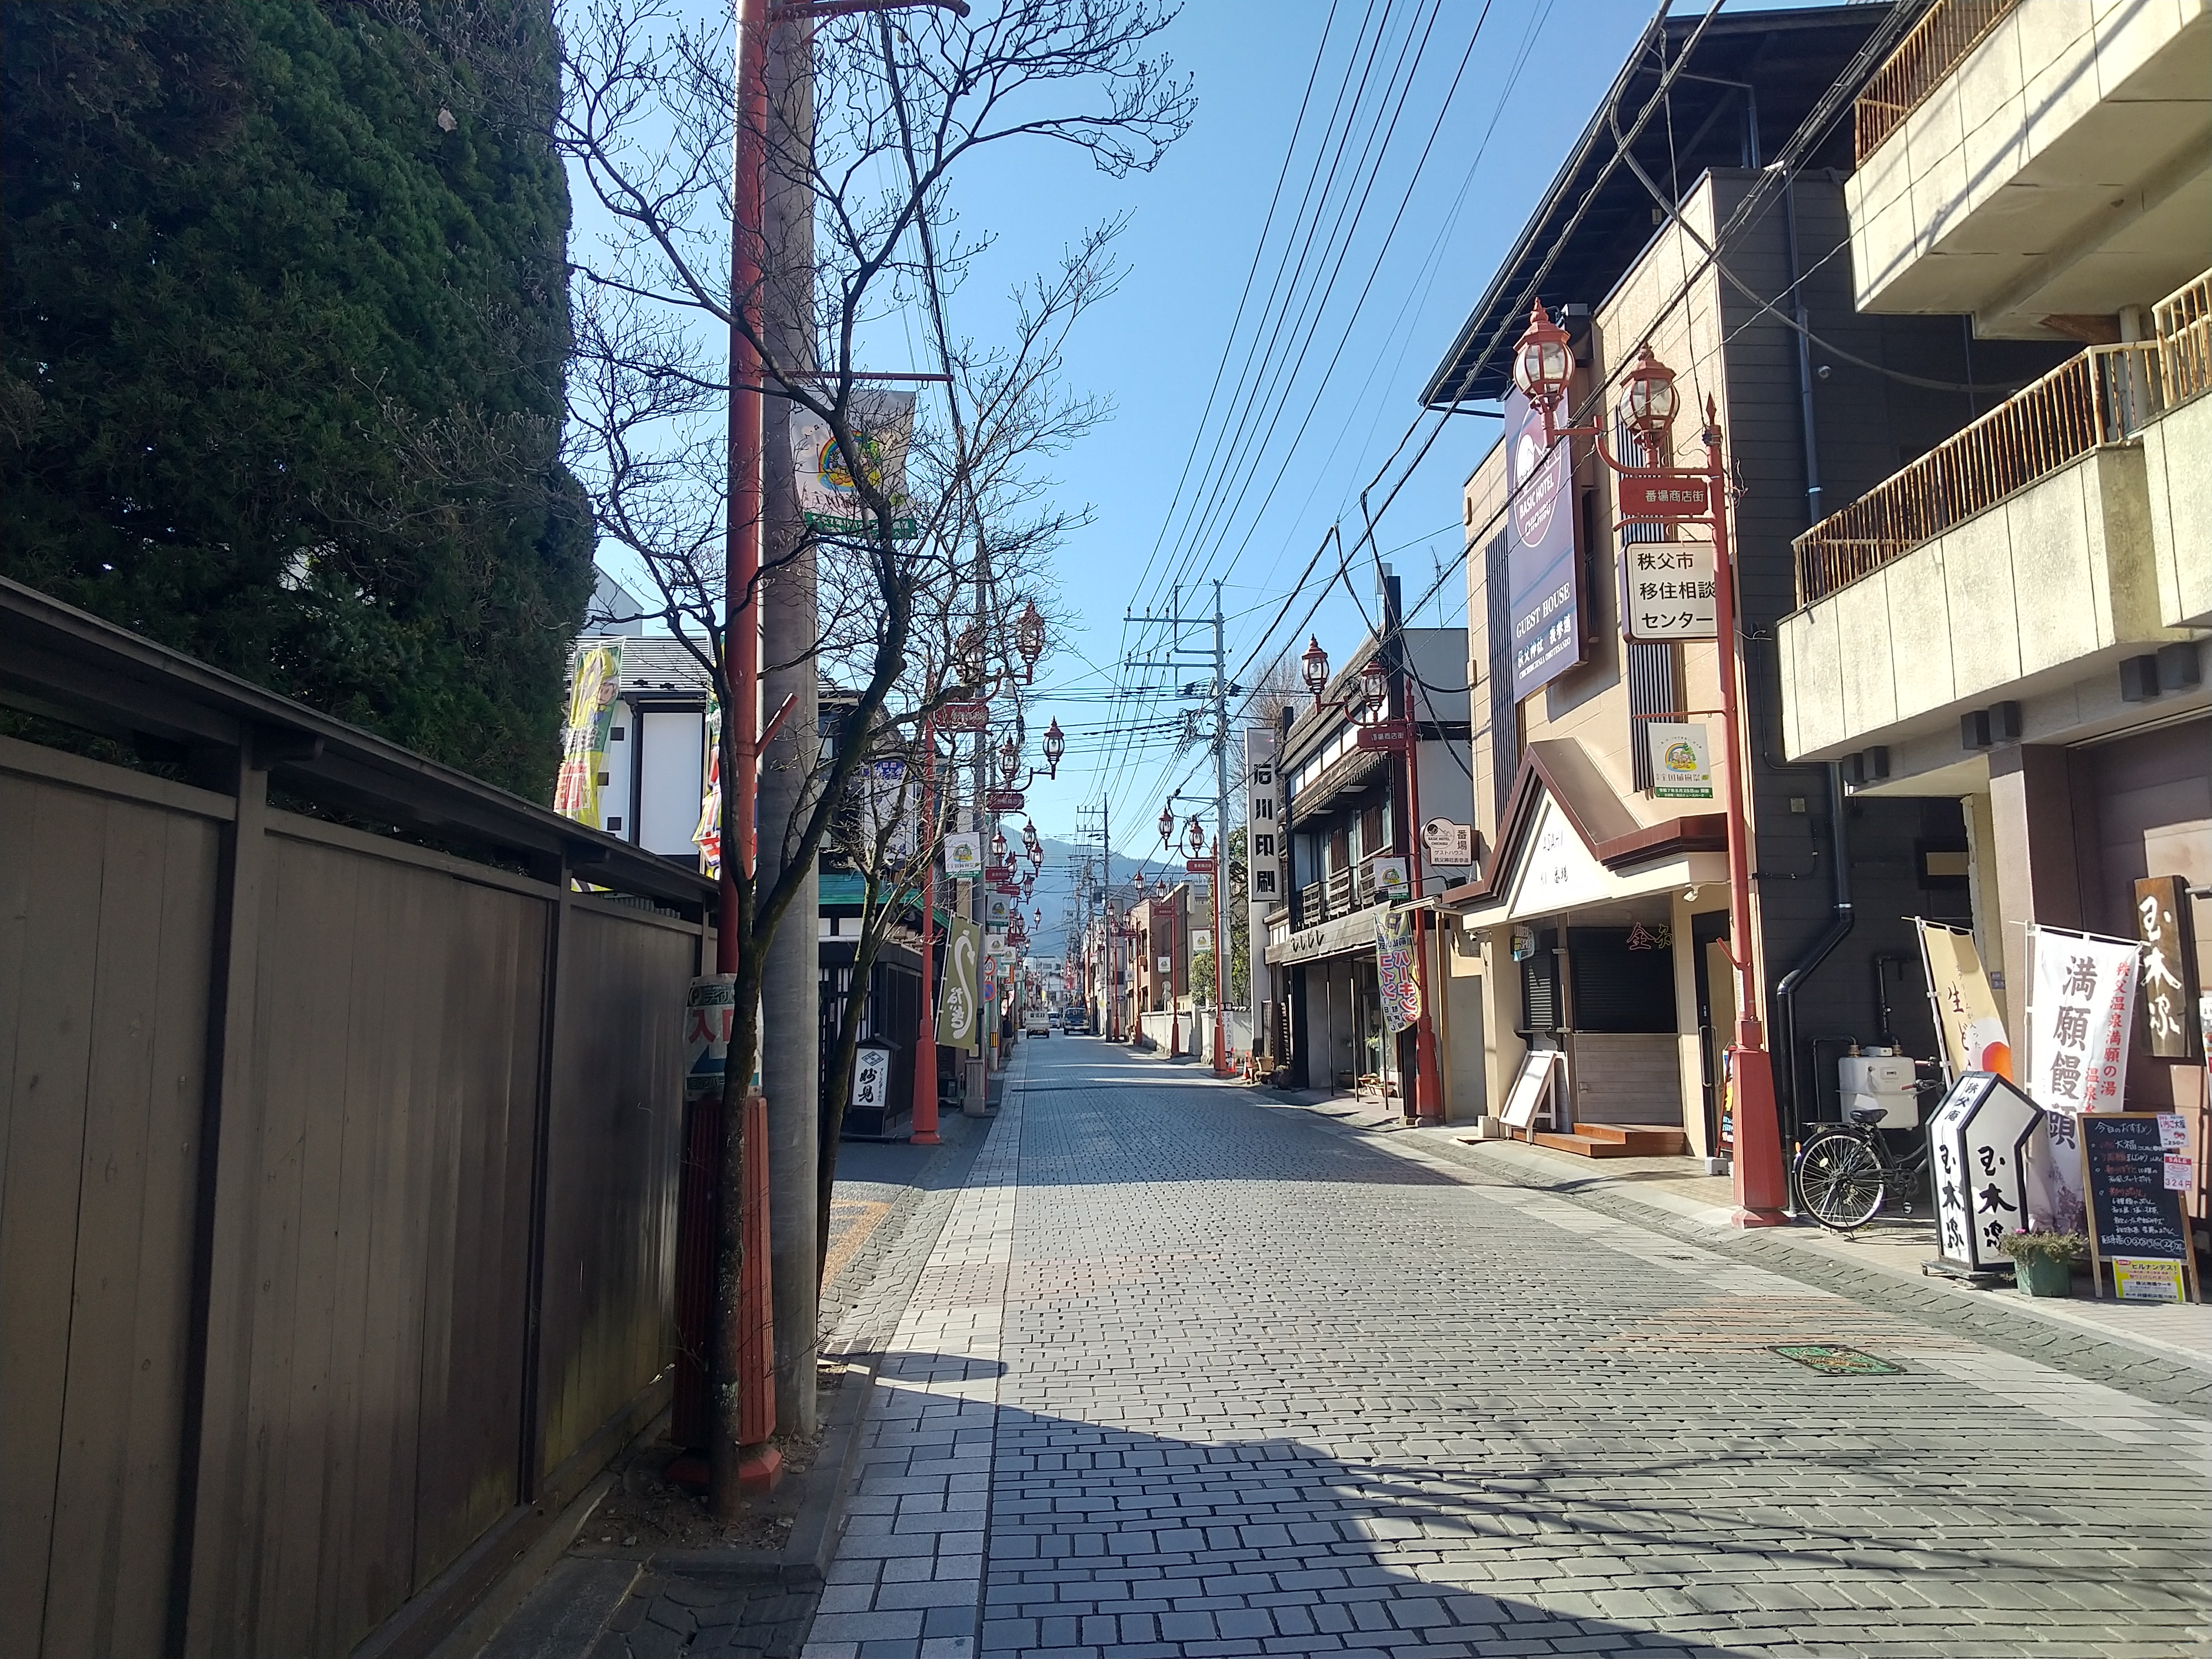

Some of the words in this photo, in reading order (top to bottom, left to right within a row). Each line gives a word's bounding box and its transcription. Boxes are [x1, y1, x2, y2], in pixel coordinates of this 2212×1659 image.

[1519, 491, 1536, 520] BASIC
[1536, 472, 1554, 503] HOTEL
[1645, 489, 1704, 503] 番場商店街
[1637, 551, 1694, 571] 秩父市
[1640, 581, 1716, 601] 移住相談
[1516, 606, 1540, 638] GUEST
[1542, 582, 1570, 618] HOUSE
[1641, 611, 1713, 629] センター
[1518, 636, 1544, 668] 秩父神社
[1550, 613, 1571, 644] 表参道
[1254, 764, 1275, 893] 石川印刷
[1457, 830, 1467, 850] 番場
[2100, 962, 2130, 1097] 秩父温泉満願の湯
[2049, 955, 2098, 1150] 満願饅頭
[858, 1068, 878, 1103] 妙見
[2095, 1121, 2152, 1135] 今日のおすすめ
